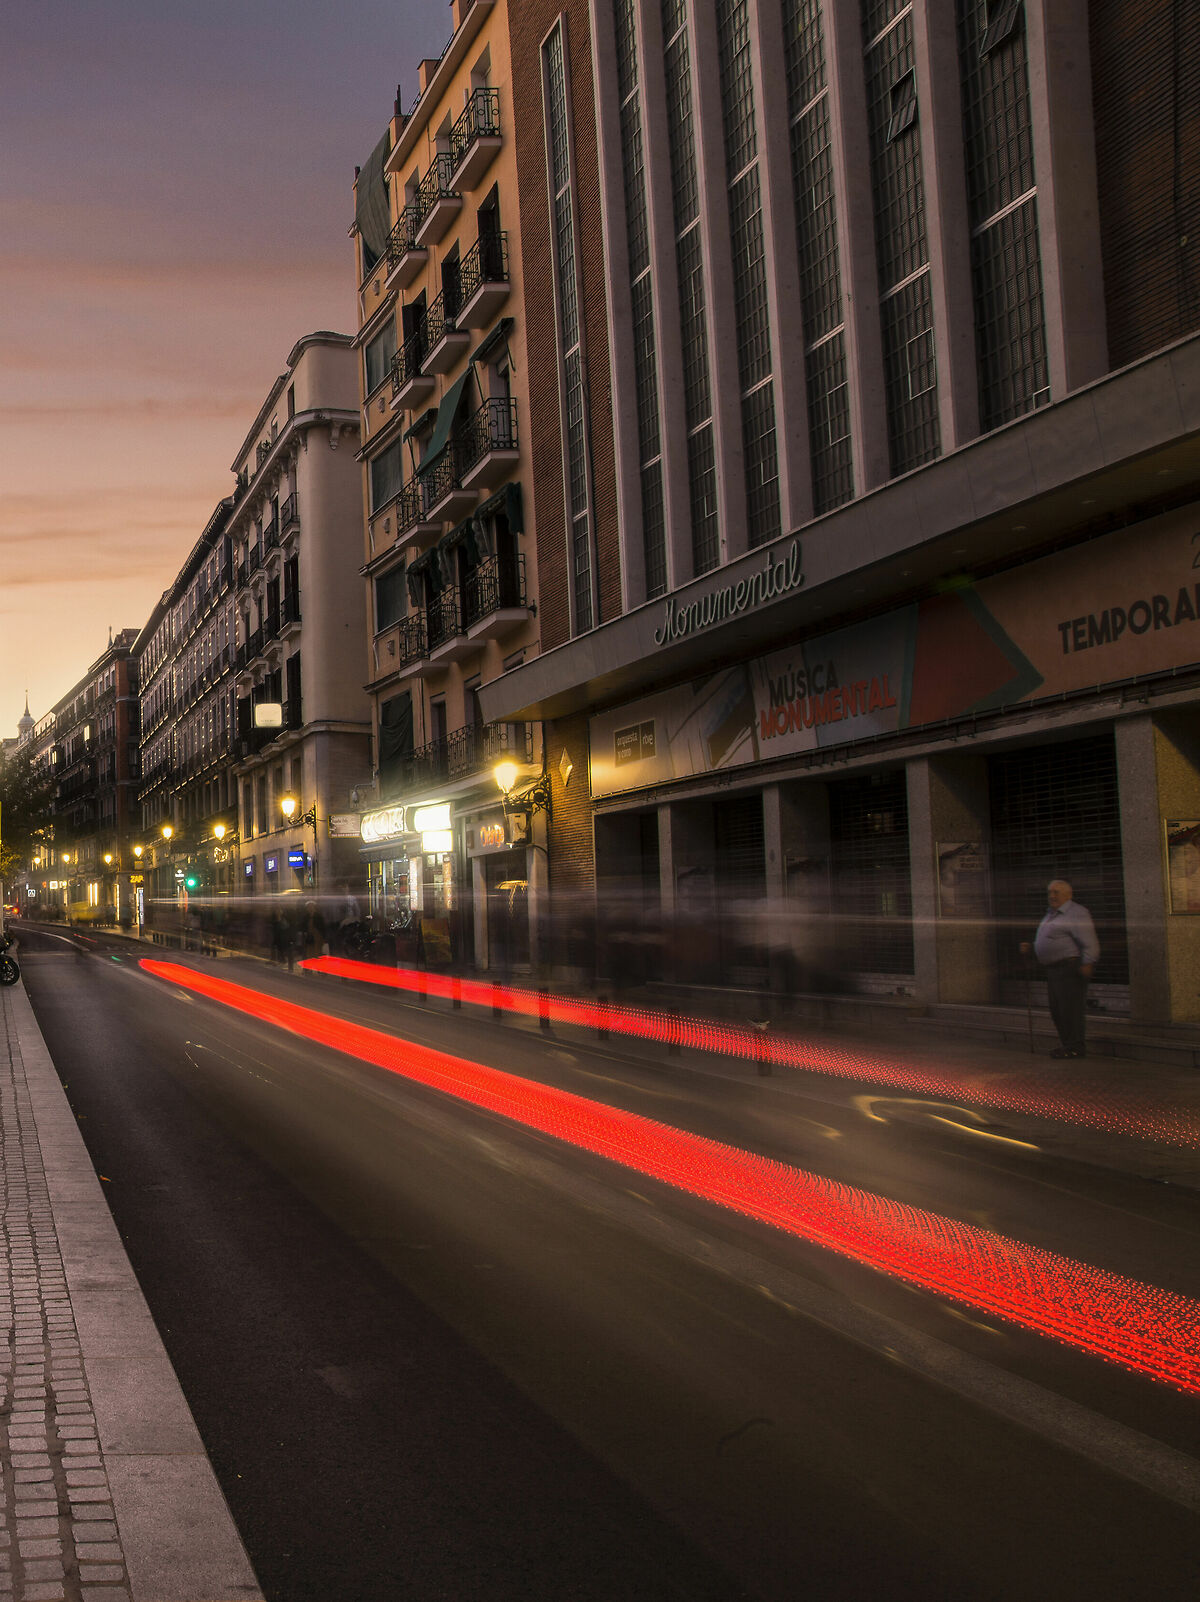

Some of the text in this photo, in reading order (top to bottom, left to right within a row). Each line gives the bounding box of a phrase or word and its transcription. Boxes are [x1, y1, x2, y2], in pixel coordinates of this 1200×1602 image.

[655, 539, 801, 645] Monumental
[760, 673, 897, 740] MONUMENTAL
[769, 659, 839, 707] MÚSICA
